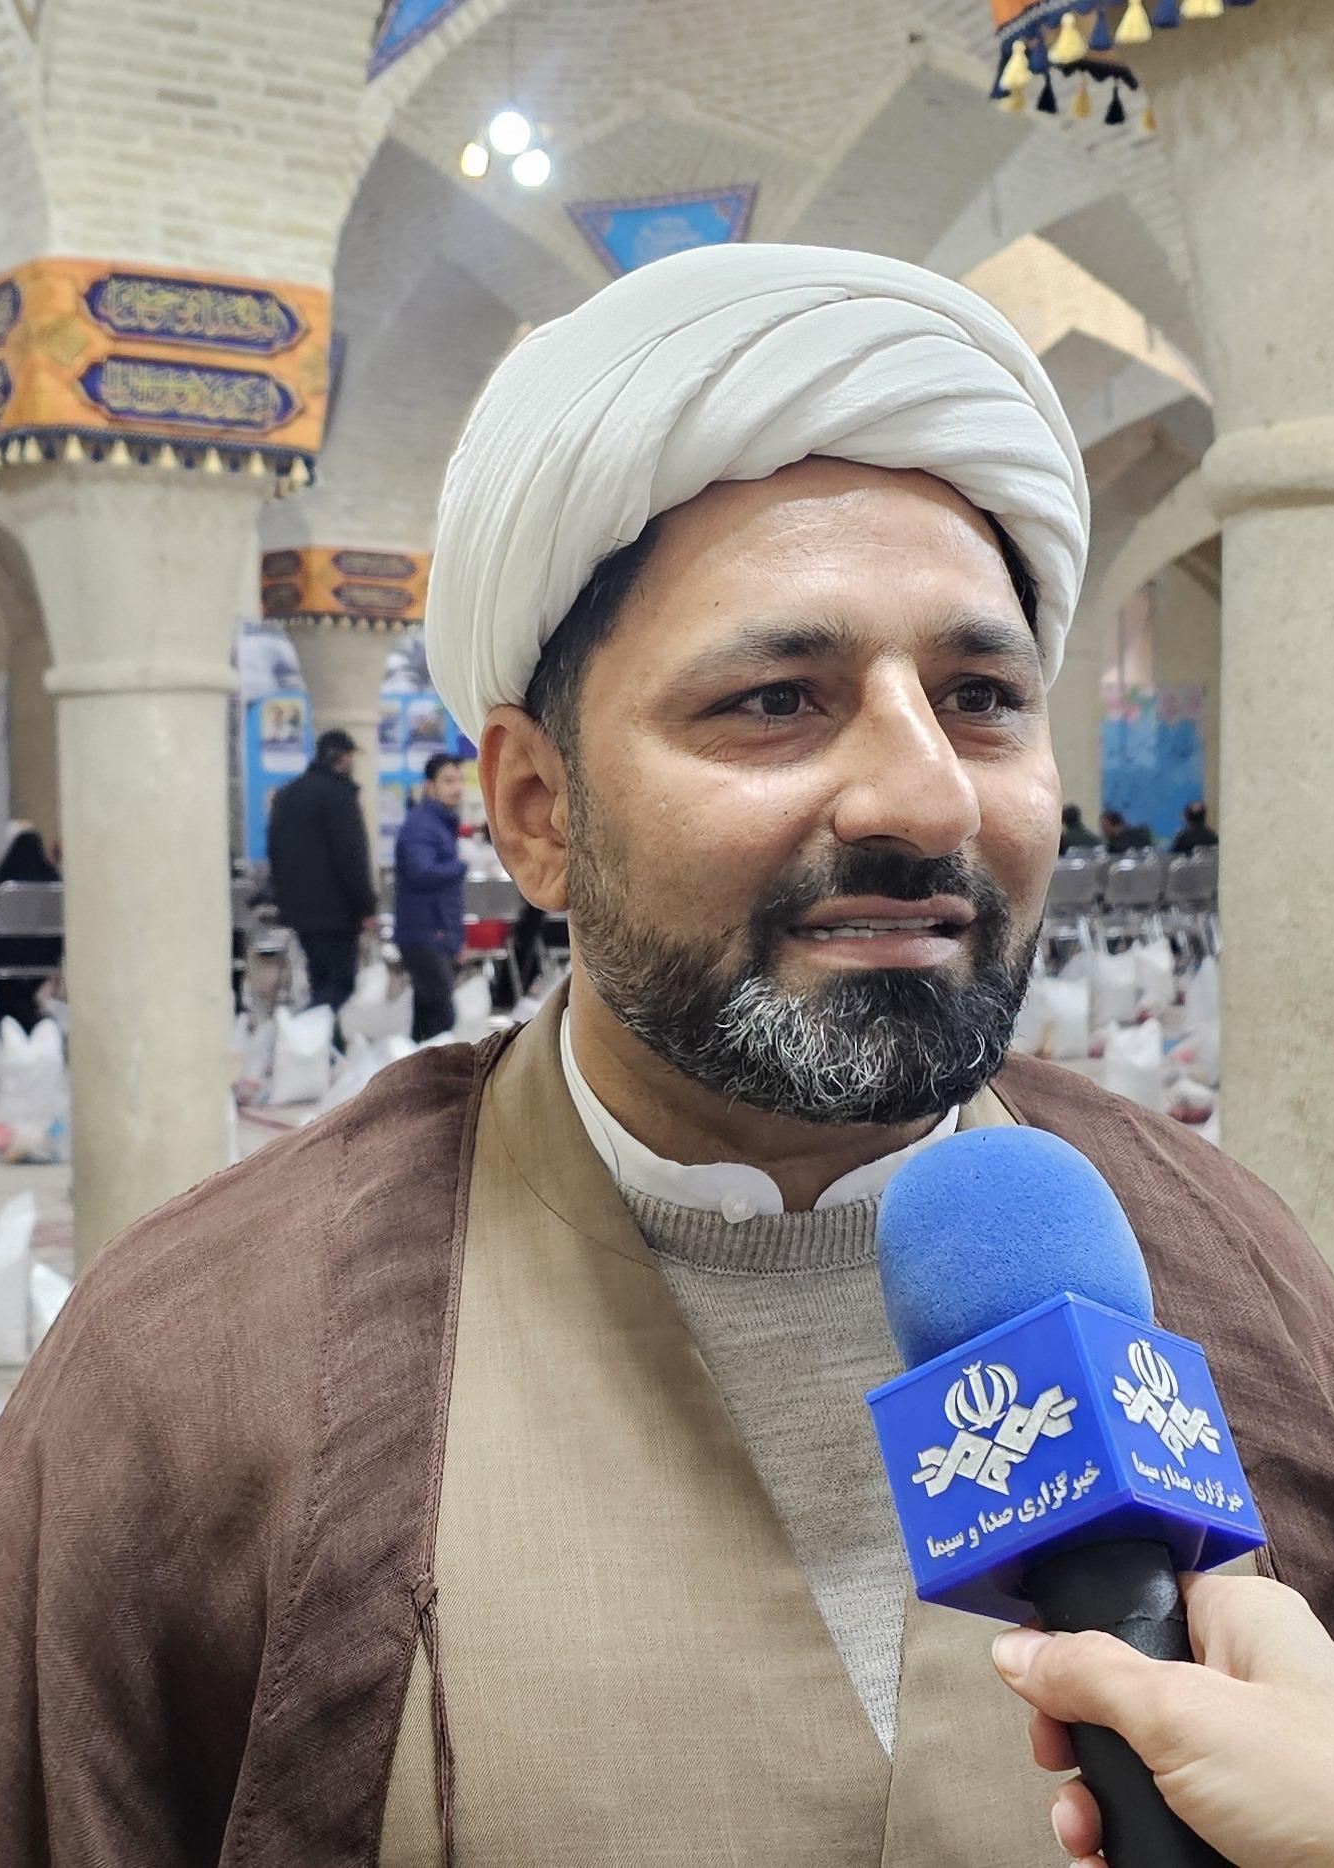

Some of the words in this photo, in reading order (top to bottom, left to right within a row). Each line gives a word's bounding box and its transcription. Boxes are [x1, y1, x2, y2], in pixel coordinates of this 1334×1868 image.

[1131, 1451, 1160, 1484] سیما
[1160, 1469, 1172, 1491] و
[1165, 1463, 1191, 1491] صدا
[978, 1506, 1014, 1534] صدا
[926, 1531, 965, 1558] سیما
[968, 1526, 980, 1549] و
